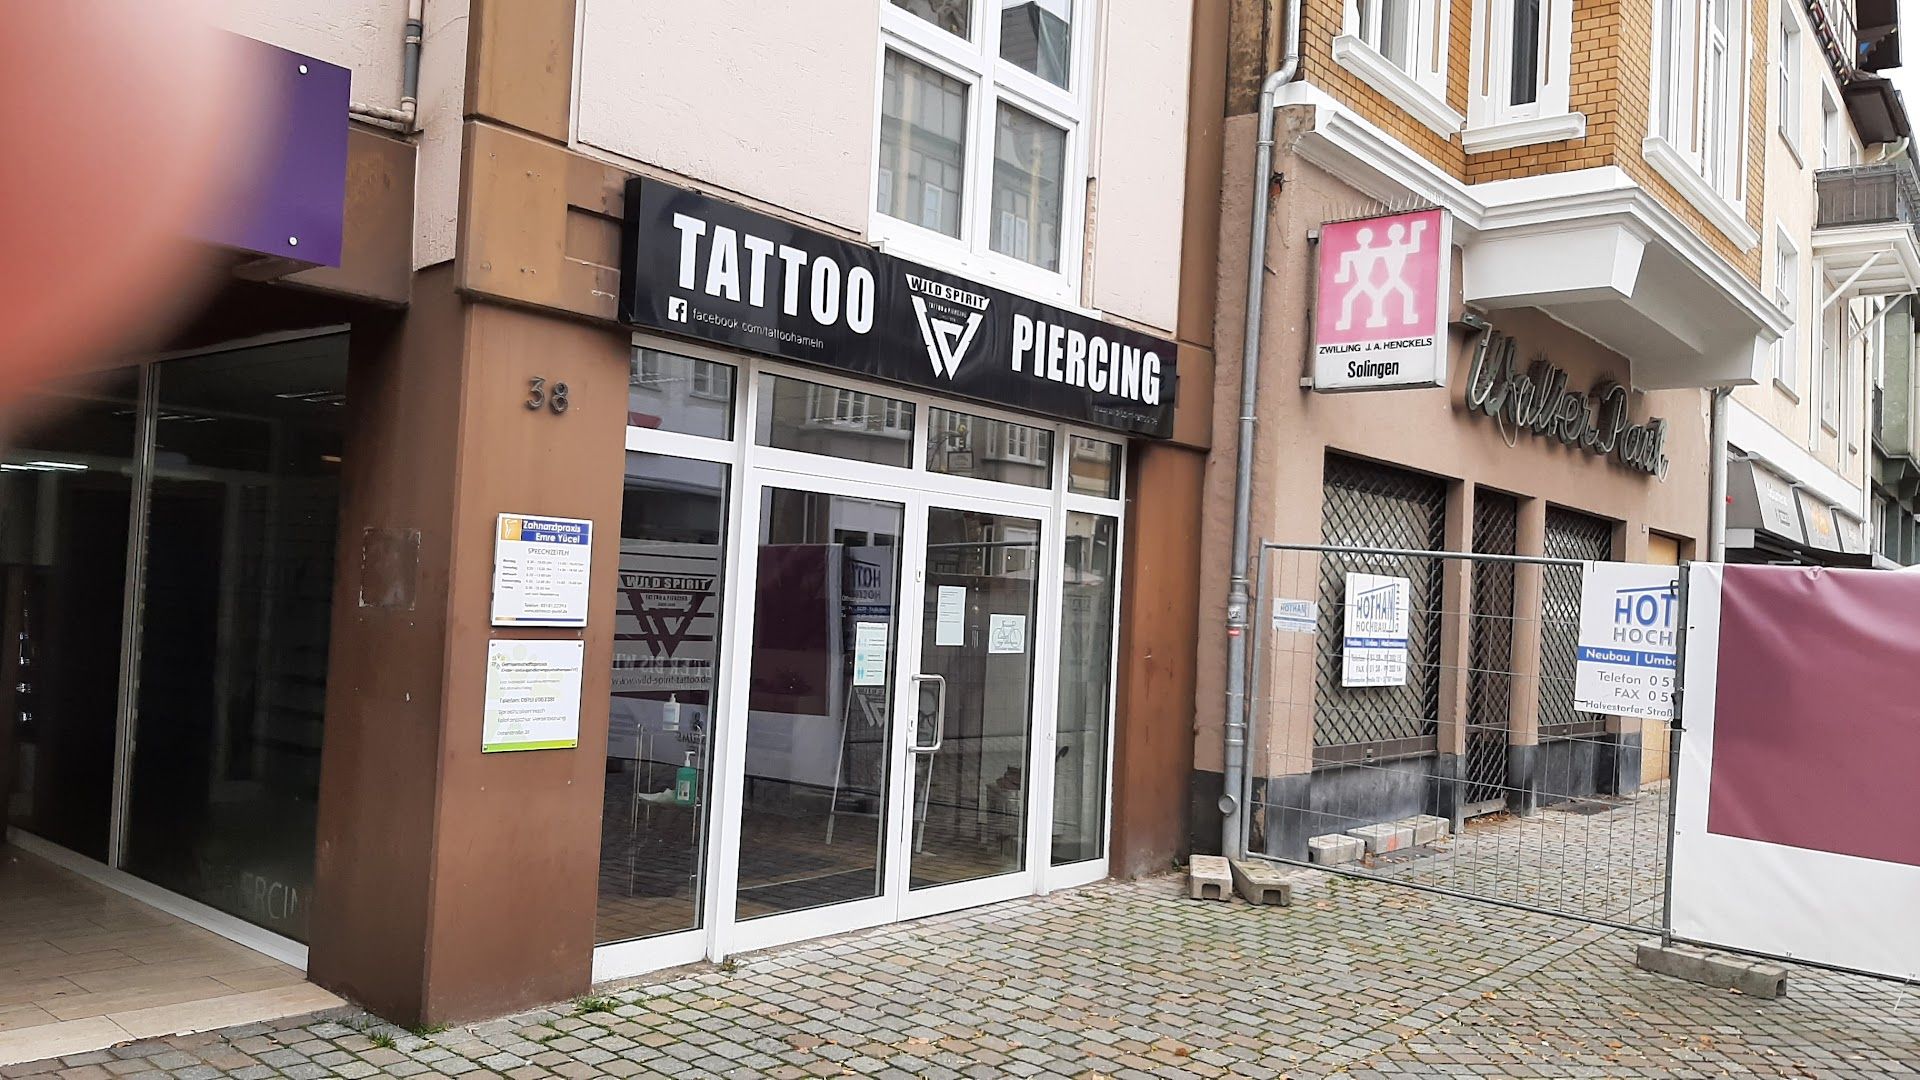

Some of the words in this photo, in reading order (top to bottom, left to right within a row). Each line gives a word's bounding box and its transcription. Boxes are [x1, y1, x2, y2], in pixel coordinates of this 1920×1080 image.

[673, 212, 875, 334] TATTOO
[911, 276, 942, 296] WILD
[945, 287, 984, 308] SPIRIT
[1319, 343, 1361, 354] ZWILLING
[1383, 338, 1432, 349] HENCKELS
[1011, 313, 1161, 405] PIERCING
[1347, 360, 1399, 379] Solingen
[527, 376, 569, 415] 38
[535, 532, 557, 542] Emre
[558, 533, 580, 544] Yücel
[626, 575, 660, 589] WILD
[664, 577, 709, 590] SPIRIT
[1586, 649, 1631, 663] Neubau
[1597, 671, 1641, 685] Telefon
[1614, 687, 1640, 700] FAX
